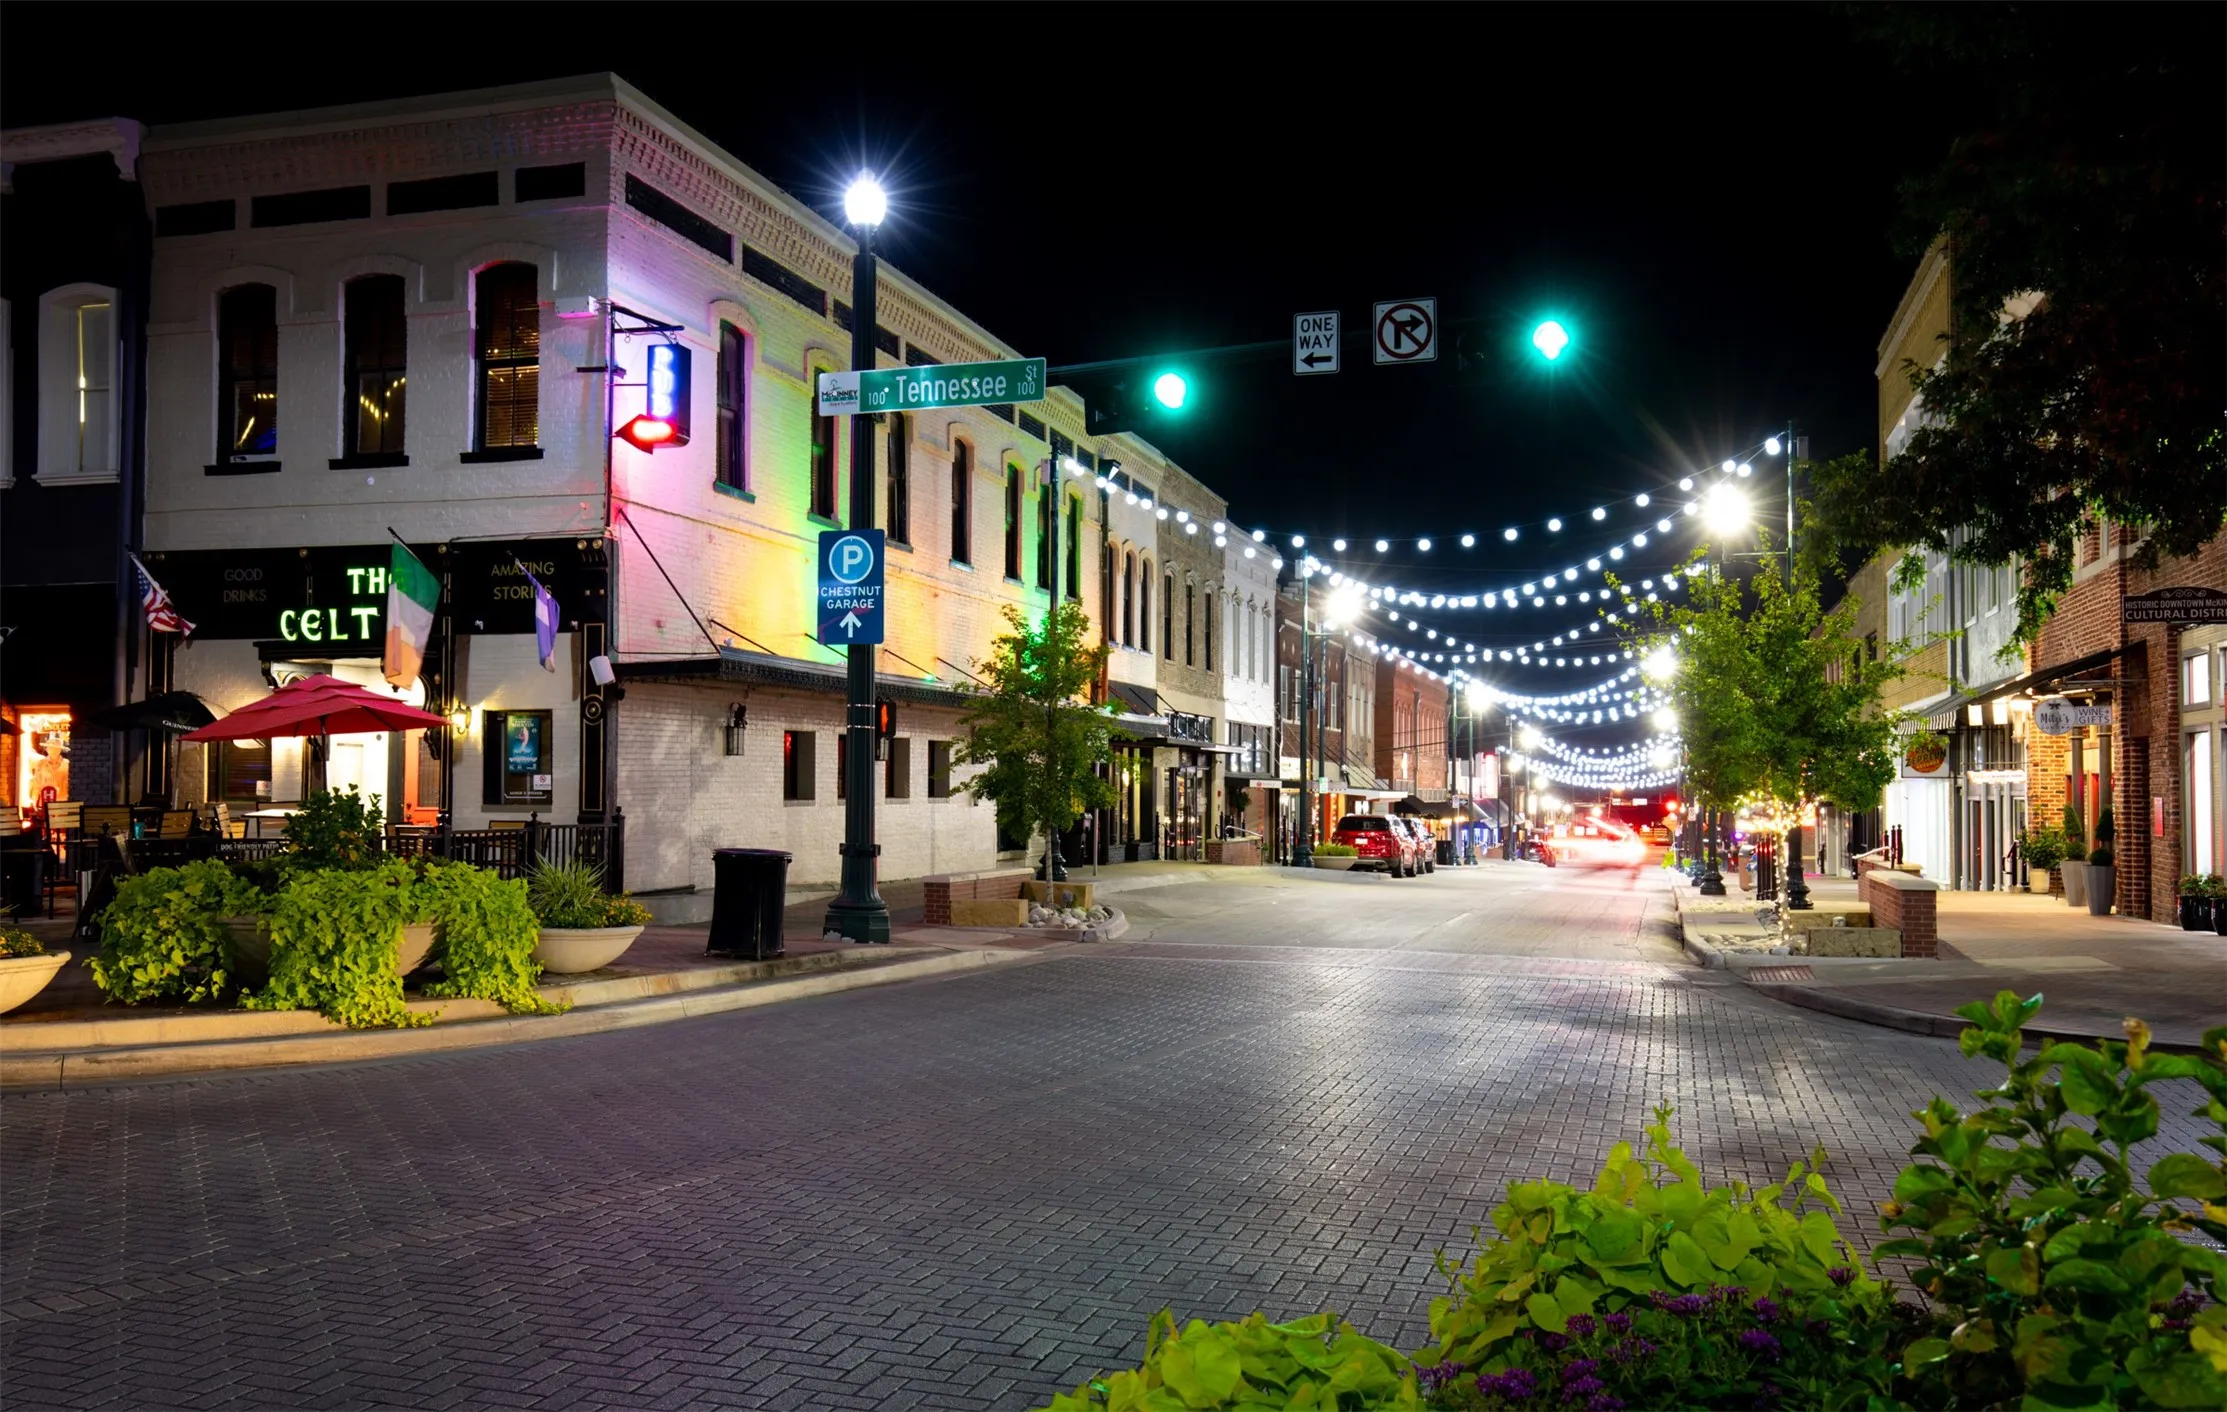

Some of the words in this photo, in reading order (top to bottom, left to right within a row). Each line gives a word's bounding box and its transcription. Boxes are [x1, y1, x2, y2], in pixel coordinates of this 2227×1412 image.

[1301, 317, 1333, 332] ONE
[1300, 334, 1333, 350] WAY
[868, 391, 885, 406] 100
[896, 375, 1007, 403] Tennessee
[1026, 365, 1037, 379] St
[1018, 381, 1036, 396] 100
[224, 568, 263, 581] GOOD
[491, 561, 555, 577] AMAZING
[347, 567, 392, 594] TH
[223, 589, 267, 603] DRINKS
[493, 585, 552, 600] STORIS
[820, 586, 881, 597] CHESTNUT
[826, 599, 875, 609] GARAGE
[2161, 599, 2204, 608] DOWNTOWN
[2125, 610, 2187, 619] CULTURAL
[280, 607, 379, 641] CELT
[2079, 716, 2110, 724] GIFTS
